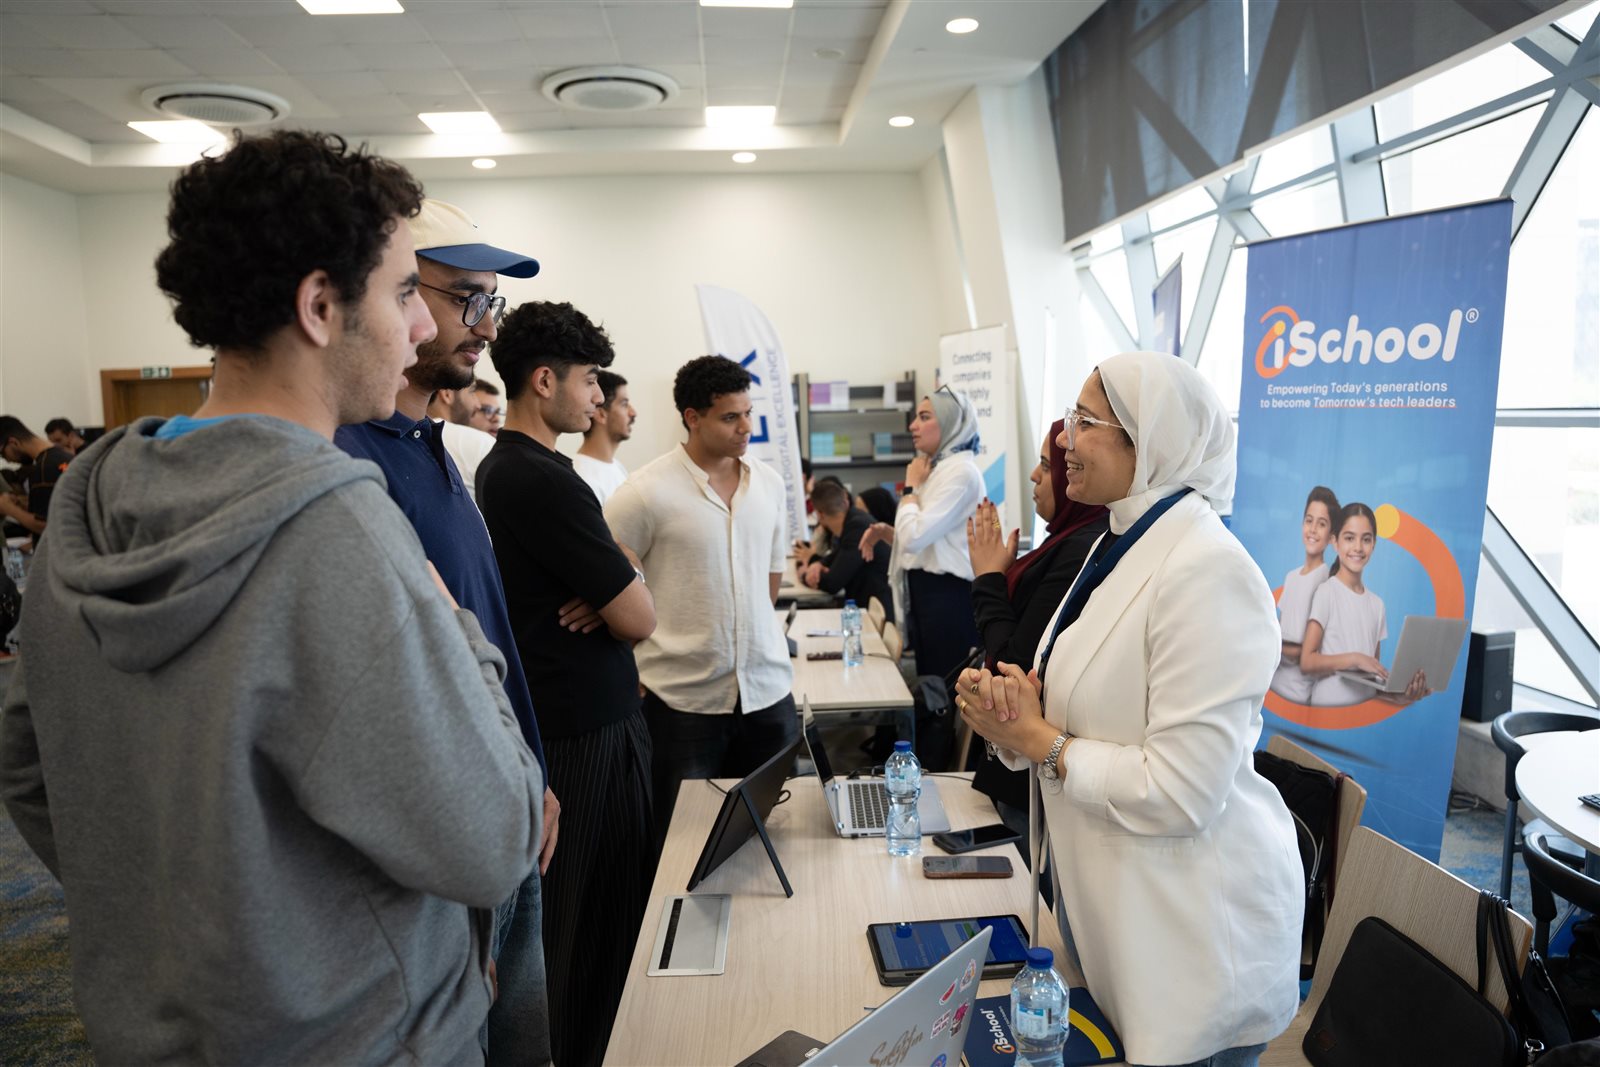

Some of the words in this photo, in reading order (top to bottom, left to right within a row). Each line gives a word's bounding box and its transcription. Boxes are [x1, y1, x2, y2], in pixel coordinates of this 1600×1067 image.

[952, 350, 992, 365] Connecting
[1256, 306, 1463, 378] iSchool
[766, 348, 786, 428] EXCELLENCE
[1260, 398, 1270, 408] to
[1272, 398, 1311, 408] become
[1314, 396, 1376, 407] Tomorrow's
[1379, 395, 1404, 407] tech
[1407, 395, 1457, 408] leaders
[1267, 383, 1329, 396] Empowering
[1331, 382, 1372, 394] Today's
[1374, 380, 1448, 395] generations
[779, 432, 793, 480] DIGITAL
[980, 1008, 1015, 1054] iSchool
